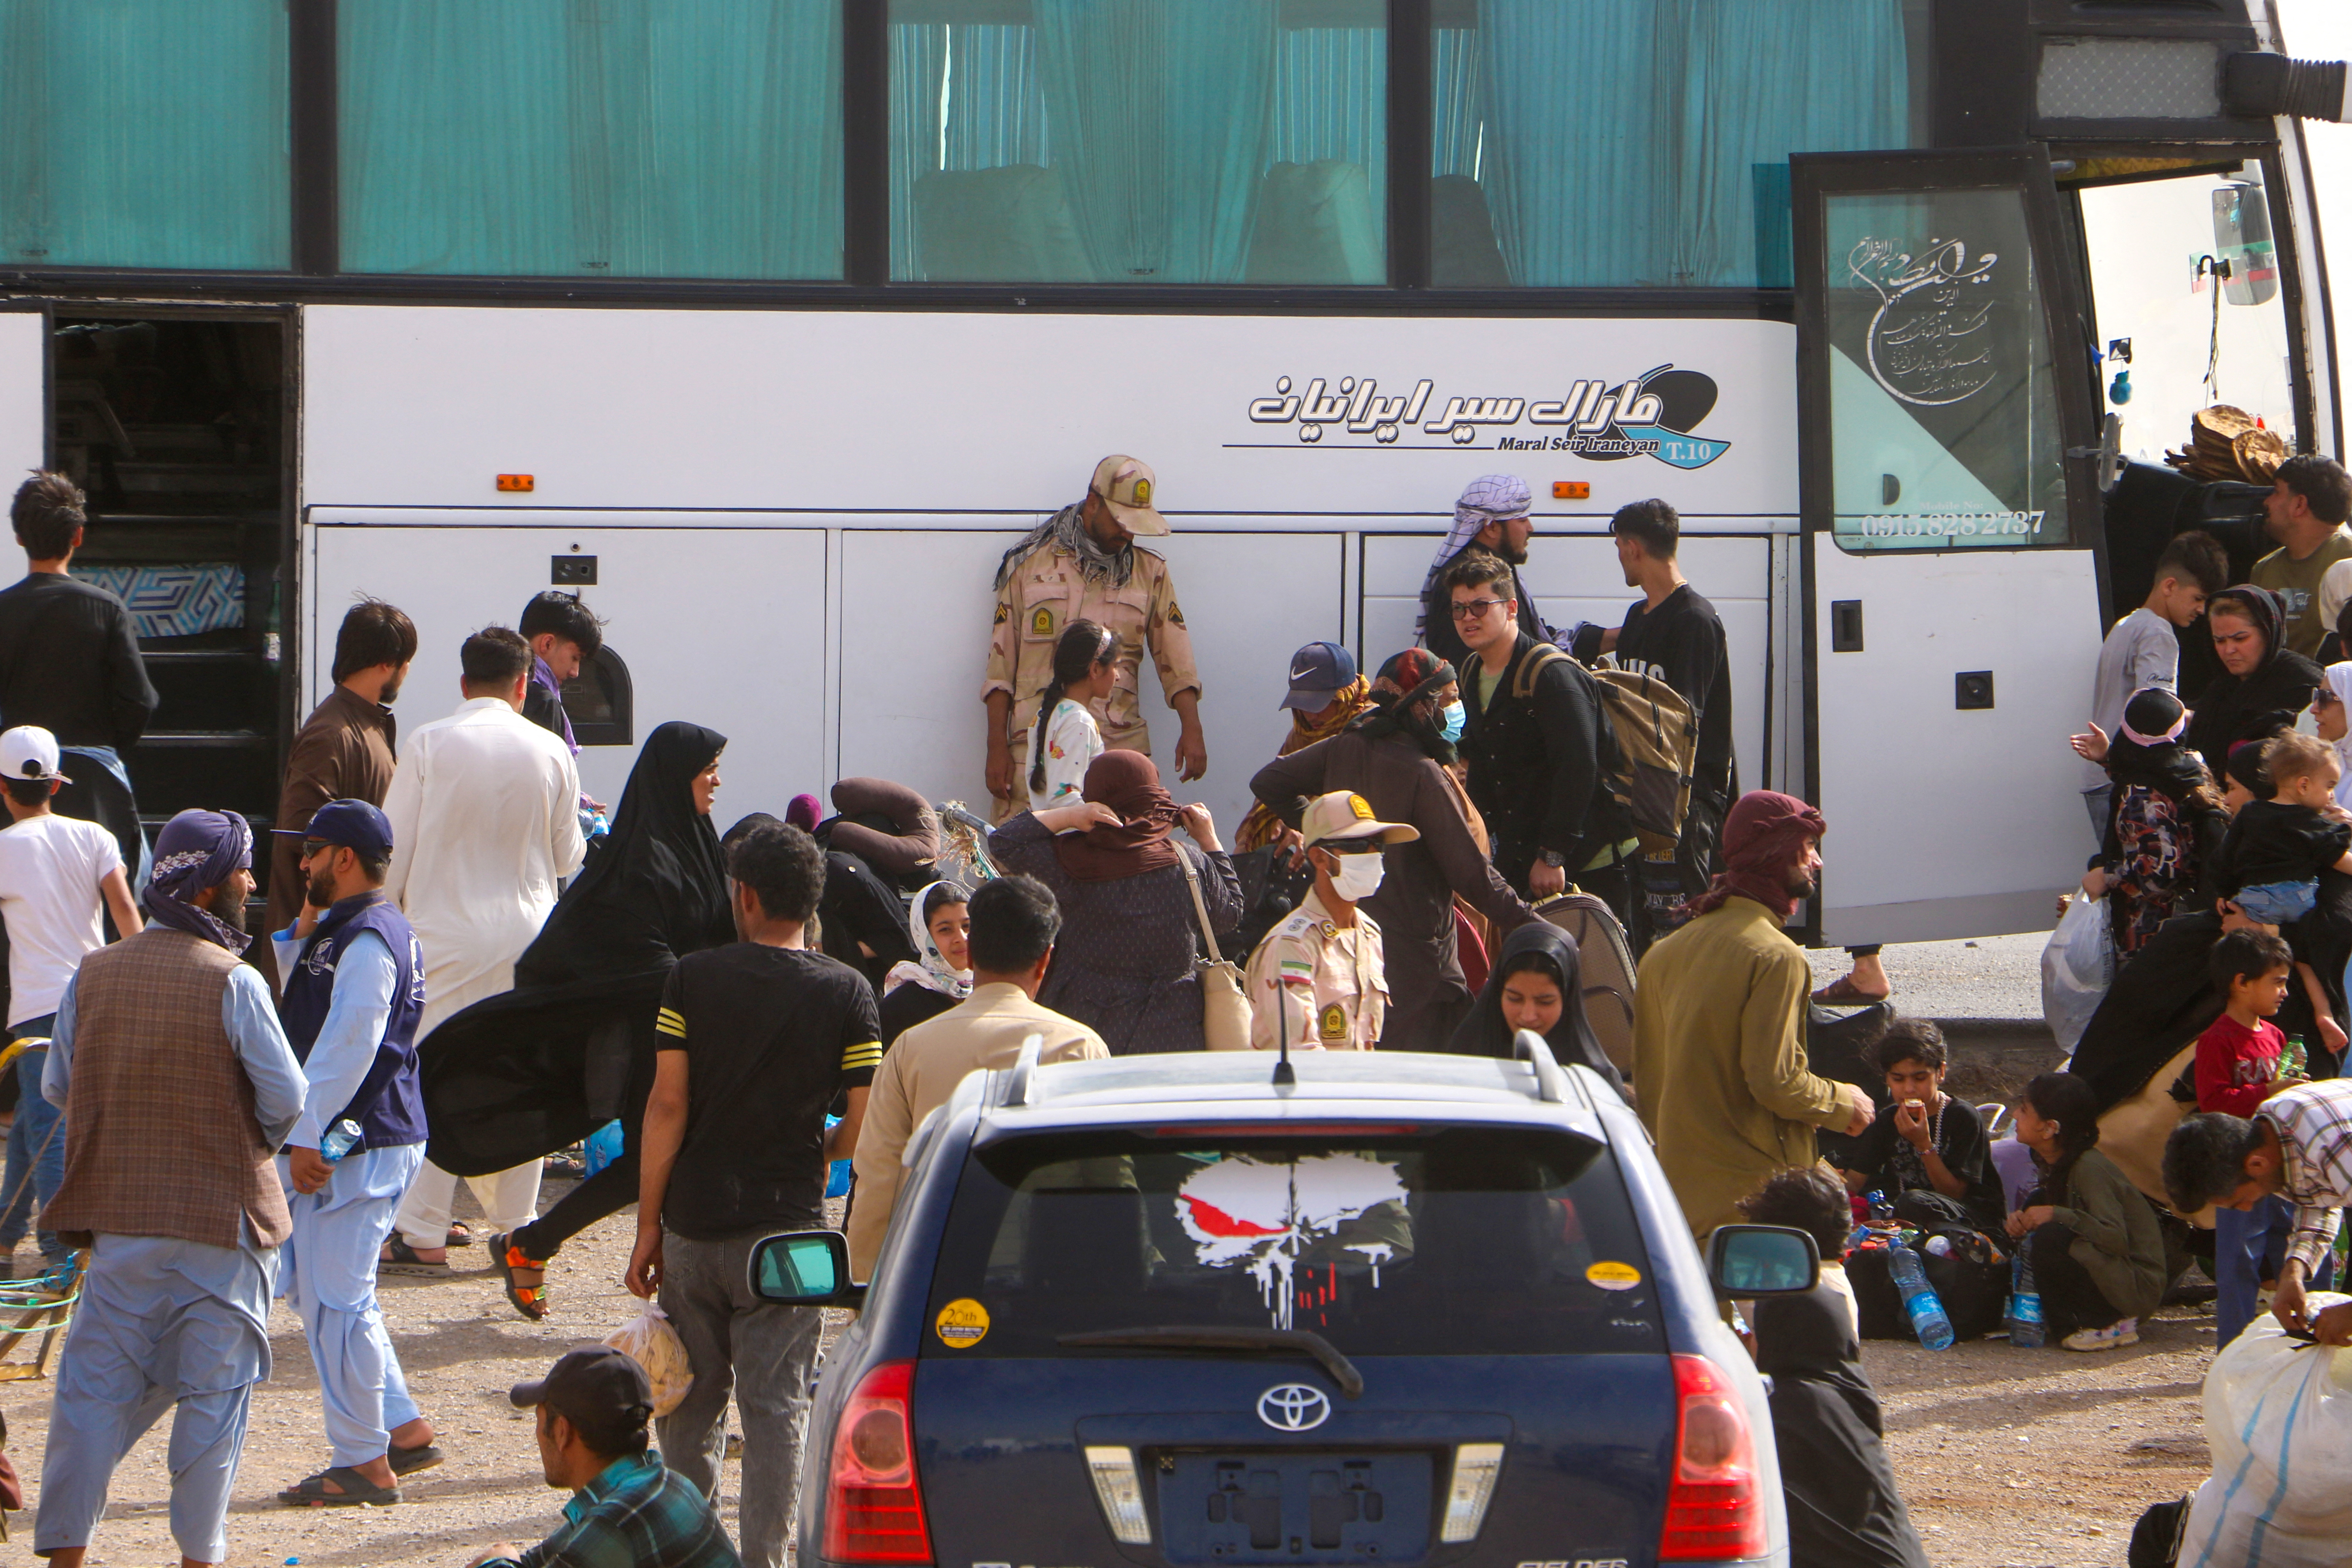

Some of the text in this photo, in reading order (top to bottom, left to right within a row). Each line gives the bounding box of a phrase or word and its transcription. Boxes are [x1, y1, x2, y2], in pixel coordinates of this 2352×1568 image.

[1248, 376, 1661, 444] مارال سیر ایرانیان
[1498, 437, 1660, 455] Maral Seir Iraneyan
[1666, 442, 1711, 460] T.10
[1920, 501, 1984, 511] Mobile No:
[1861, 510, 2045, 537] 0915 828 2737
[945, 1308, 977, 1325] 20th
